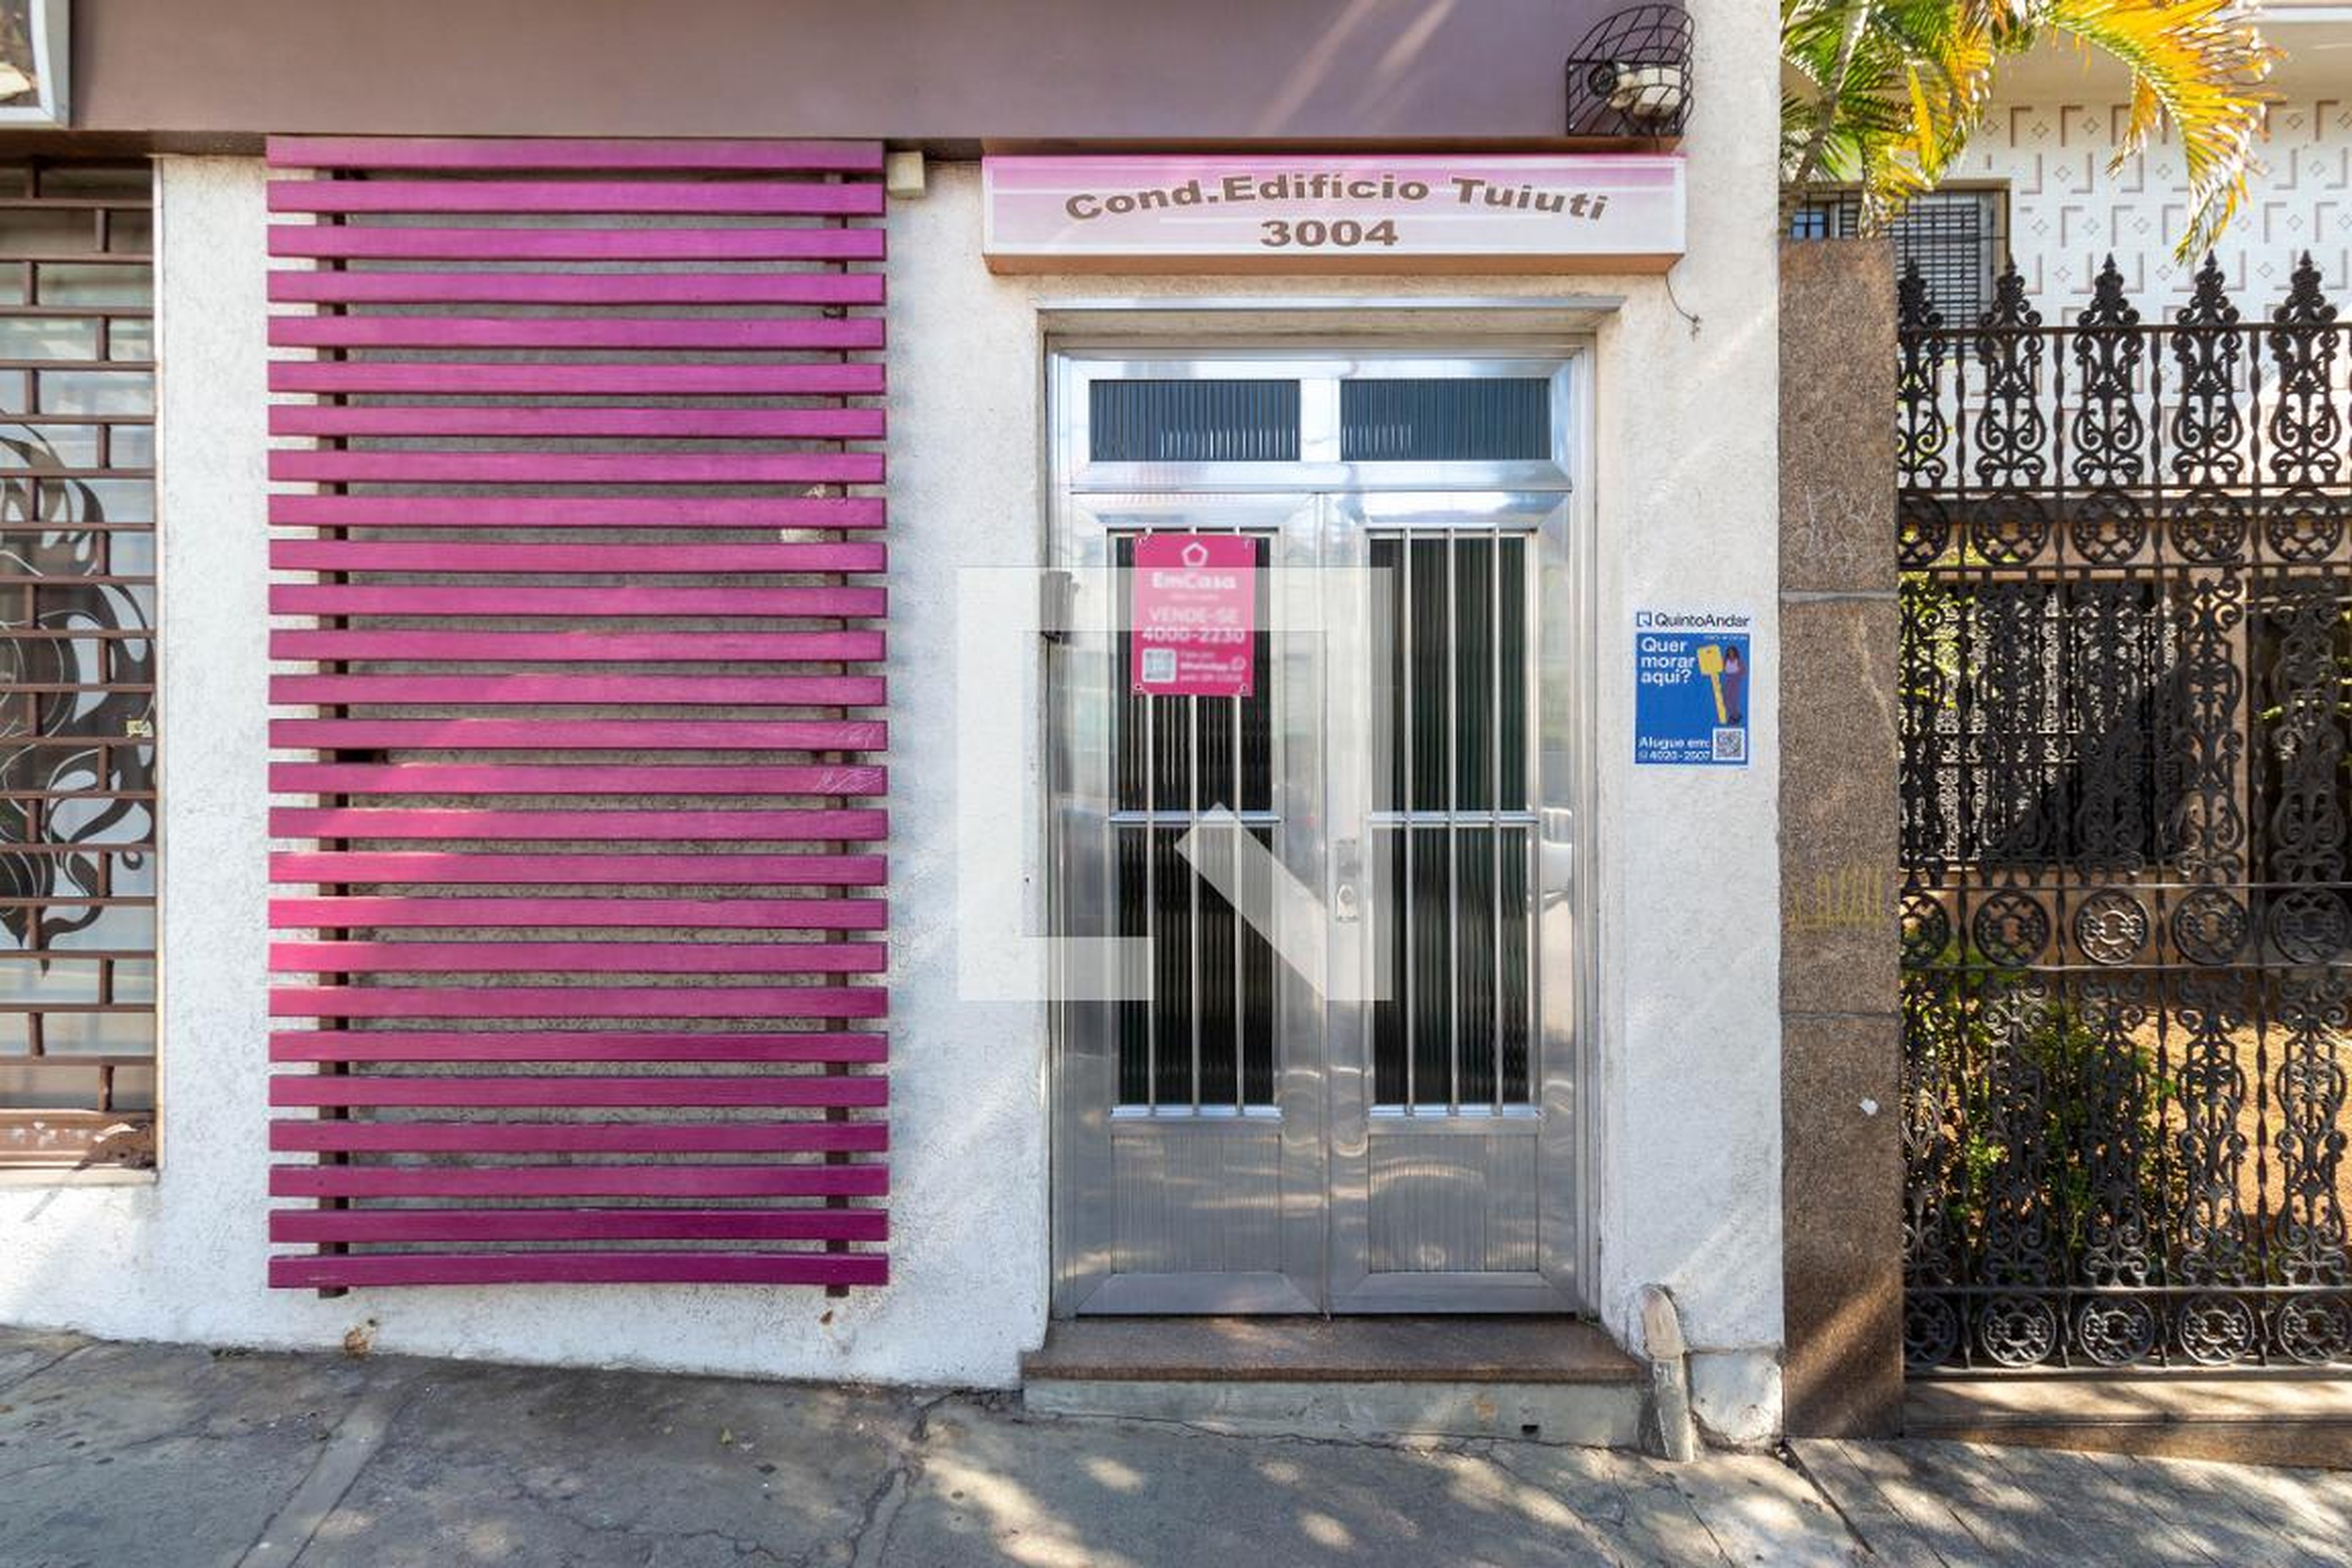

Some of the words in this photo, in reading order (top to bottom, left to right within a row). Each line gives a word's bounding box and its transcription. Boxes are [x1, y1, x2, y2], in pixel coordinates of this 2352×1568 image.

[1451, 177, 1608, 221] Tuiuti
[1260, 219, 1398, 247] 3004
[1152, 571, 1236, 589] EmCasa
[1147, 607, 1240, 625] VENDE-SE
[1655, 612, 1749, 628] QuintoAndar
[1641, 636, 1687, 653] Quer
[1641, 656, 1695, 668] morar
[1641, 669, 1692, 686] aqui?
[1638, 737, 1684, 748] Alugue
